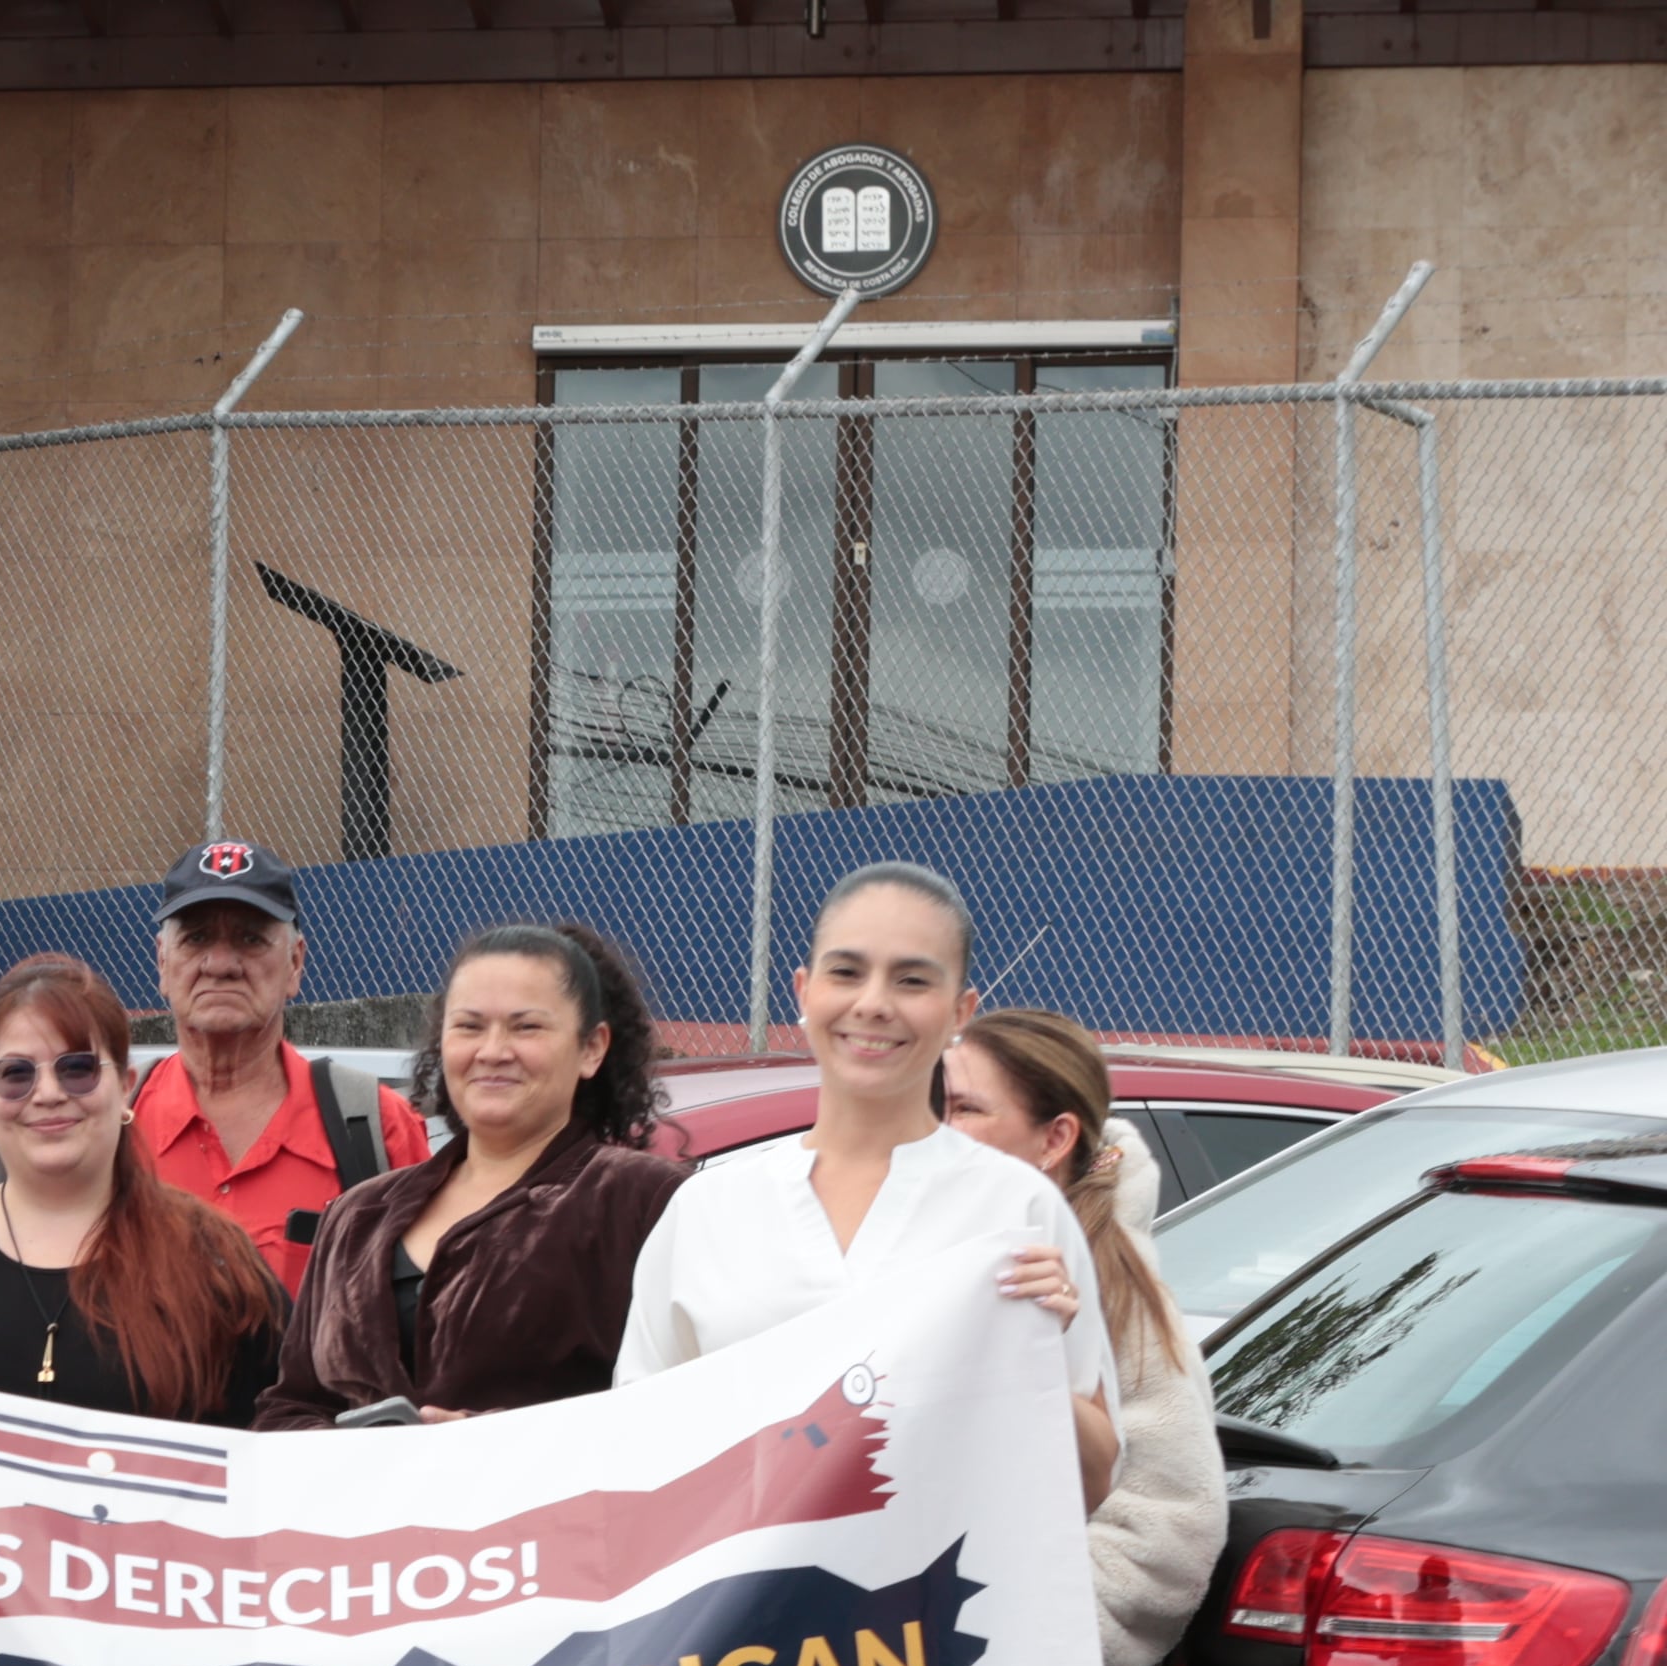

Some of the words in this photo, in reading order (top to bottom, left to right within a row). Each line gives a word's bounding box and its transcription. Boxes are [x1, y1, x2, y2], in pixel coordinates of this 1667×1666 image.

[788, 179, 811, 227] COLEGIO
[808, 166, 824, 181] DE
[824, 153, 885, 171] ABOGADOS
[887, 160, 895, 171] Y
[892, 167, 925, 222] ABOGADAS
[862, 273, 891, 288] COSTA
[48, 1540, 539, 1627] DERECHOS!
